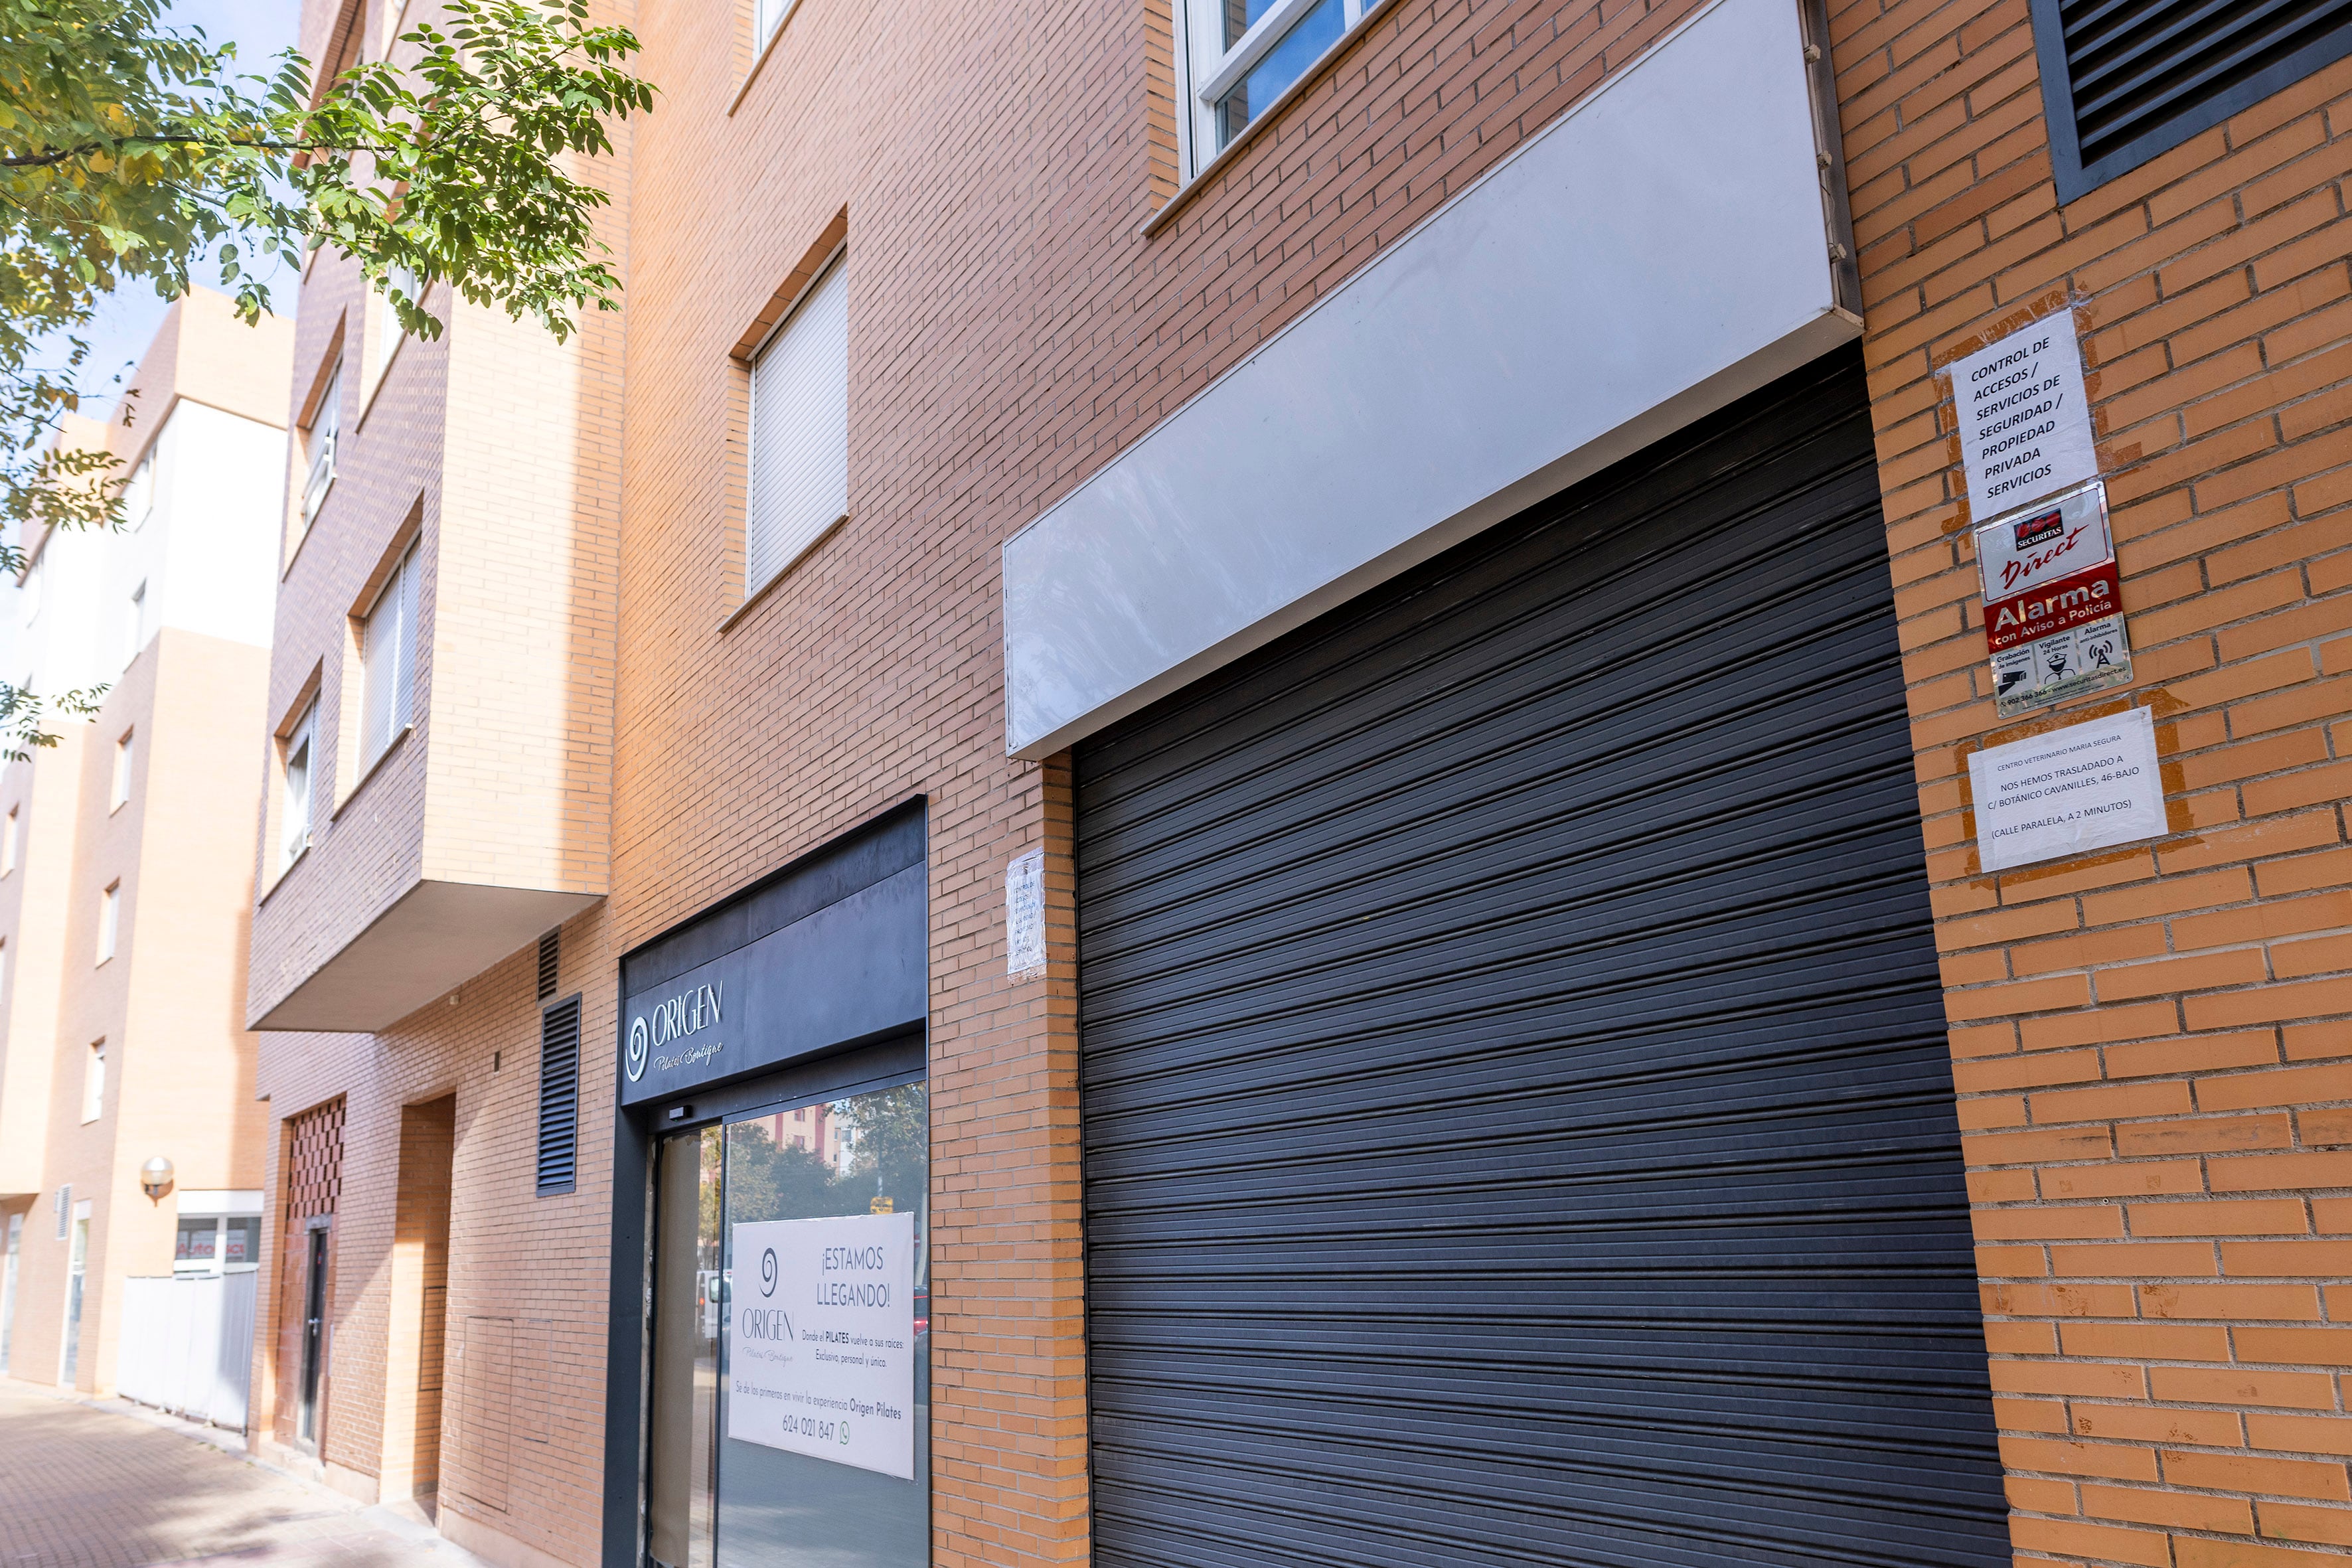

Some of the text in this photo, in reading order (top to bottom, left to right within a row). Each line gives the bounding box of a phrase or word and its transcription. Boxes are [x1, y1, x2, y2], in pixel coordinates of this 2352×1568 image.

[1971, 337, 2050, 382] CONTROL DE
[1974, 368, 2028, 402] ACCESOS
[1976, 374, 2061, 421] SERVICIOS DE
[1979, 402, 2053, 440] SEGURIDAD
[1982, 420, 2055, 459] PROPIEDAD
[1985, 447, 2041, 479] PRIVADA
[1987, 464, 2051, 499] SERVICIOS
[2017, 526, 2062, 548] SECURITAS
[1999, 524, 2090, 590] Direct
[1994, 579, 2110, 632] Alarma
[1995, 600, 2112, 646] con Aviso a Policía
[2084, 622, 2112, 635] Alarma
[1997, 649, 2030, 663] Grabación
[2039, 635, 2071, 649] Vigilante
[2051, 644, 2069, 653] Horas
[2005, 656, 2031, 667] imágenes
[2052, 666, 2126, 692] www.securitasdirect.es
[1998, 734, 2121, 771] CENTRO VETERINARIO MARIA SEGURA
[1988, 766, 2140, 811] C/ BOTÁNICO CAVANILLES, 46-BAJO
[2000, 755, 2124, 793] NOS HEMOS TRASLADADO A
[1992, 825, 2019, 840] (CALLE
[2021, 815, 2066, 832] PARALELA,
[2076, 811, 2081, 819] 2
[2084, 799, 2132, 817] MINUTOS)
[652, 979, 724, 1047] ORIGEN
[680, 1041, 724, 1066] Boutique
[822, 1245, 884, 1277] ¡ESTAMOS
[817, 1283, 890, 1308] LLEGANDO!
[742, 1308, 794, 1342] ORIGEN
[802, 1329, 819, 1342] Donde
[819, 1330, 824, 1342] el
[825, 1330, 849, 1344] PILATES
[850, 1333, 868, 1346] vuelve
[875, 1338, 884, 1348] sus
[815, 1348, 887, 1368] Exclusivo, personal y único.
[744, 1380, 750, 1394] de
[783, 1393, 791, 1401] en
[792, 1391, 805, 1403] vivir
[805, 1389, 812, 1405] la
[813, 1396, 848, 1411] experiencia
[850, 1397, 874, 1417] Origen
[876, 1401, 902, 1420] Pilates
[783, 1415, 834, 1441] 624 021 847
